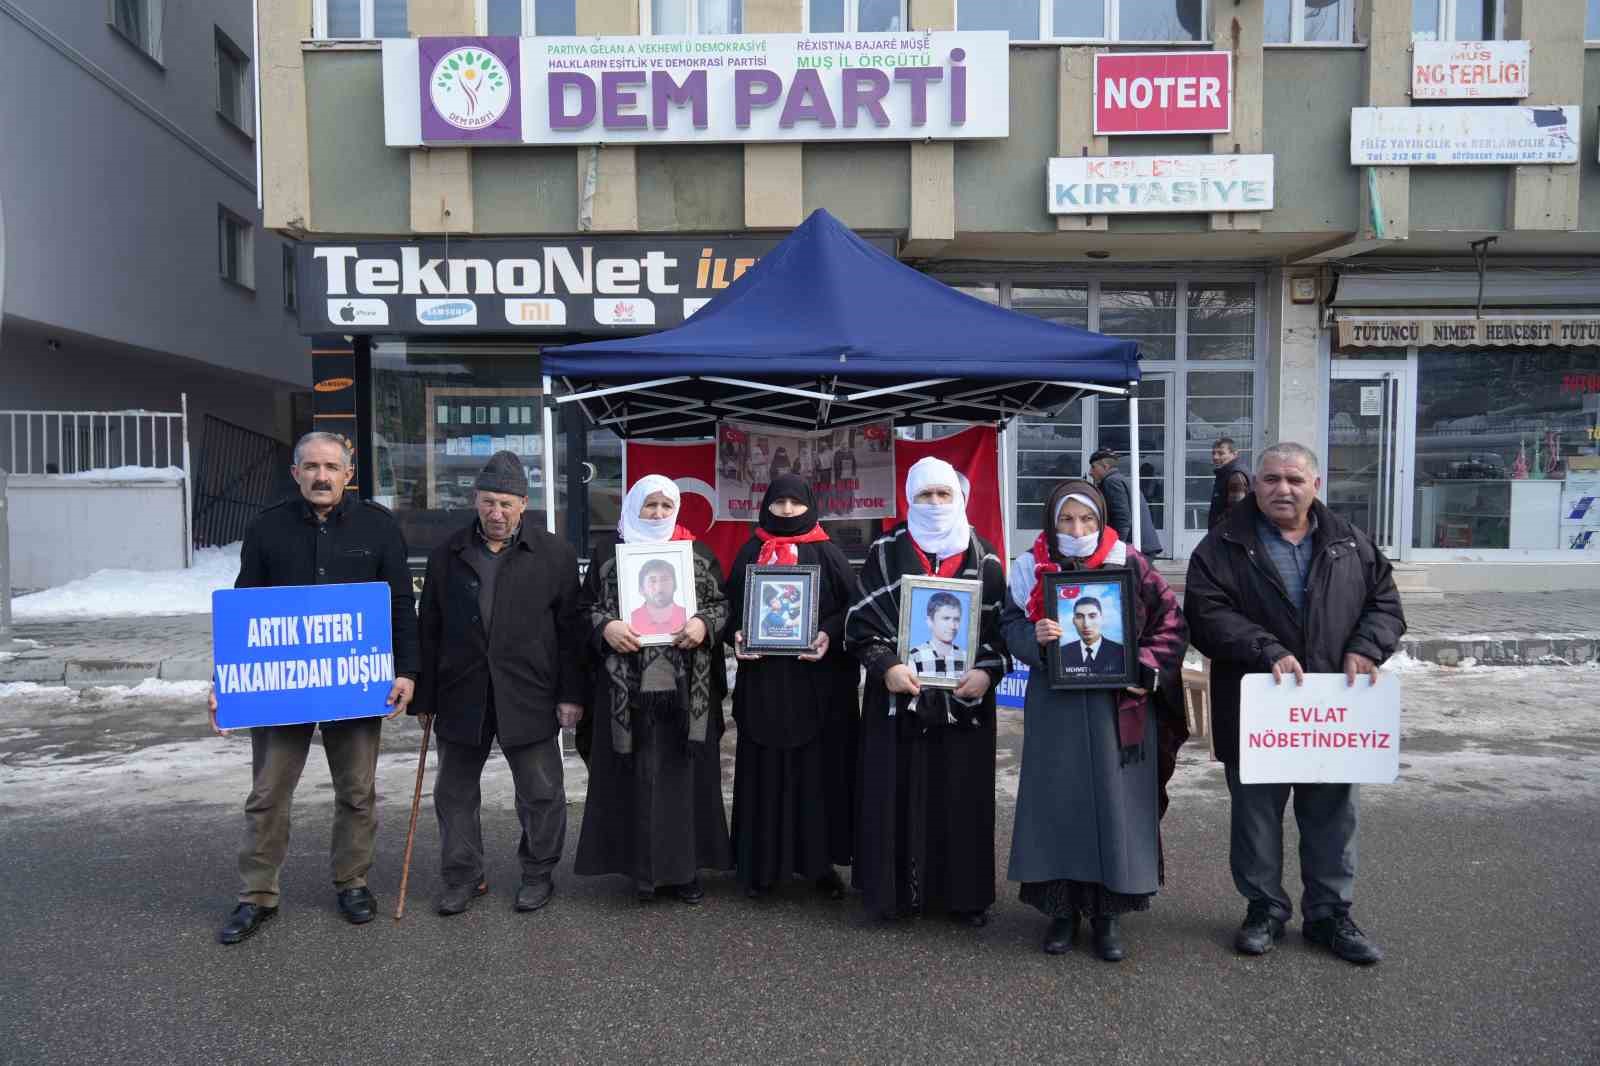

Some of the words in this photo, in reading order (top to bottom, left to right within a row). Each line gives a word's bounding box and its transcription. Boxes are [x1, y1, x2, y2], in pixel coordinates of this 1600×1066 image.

[548, 57, 608, 69] HALKLARIN
[650, 58, 664, 68] VE
[665, 56, 724, 68] DEMOKRASİ
[727, 55, 767, 67] PARTİSİ
[797, 55, 833, 69] MUŞ
[548, 71, 707, 131] DEM
[734, 47, 967, 129] PARTİ
[1104, 77, 1222, 109] NOTER
[449, 111, 468, 125] DEM
[1056, 178, 1266, 206] KIRTASİYE
[313, 246, 680, 295] TeknoNet
[248, 615, 299, 648] ARTIK
[303, 612, 353, 645] YETER
[216, 657, 332, 695] YAKAMIZDAN
[336, 646, 394, 693] DÜŞÜN
[1289, 707, 1347, 723] EVLAT
[1248, 729, 1391, 749] NÖBETİNDEYİZ
